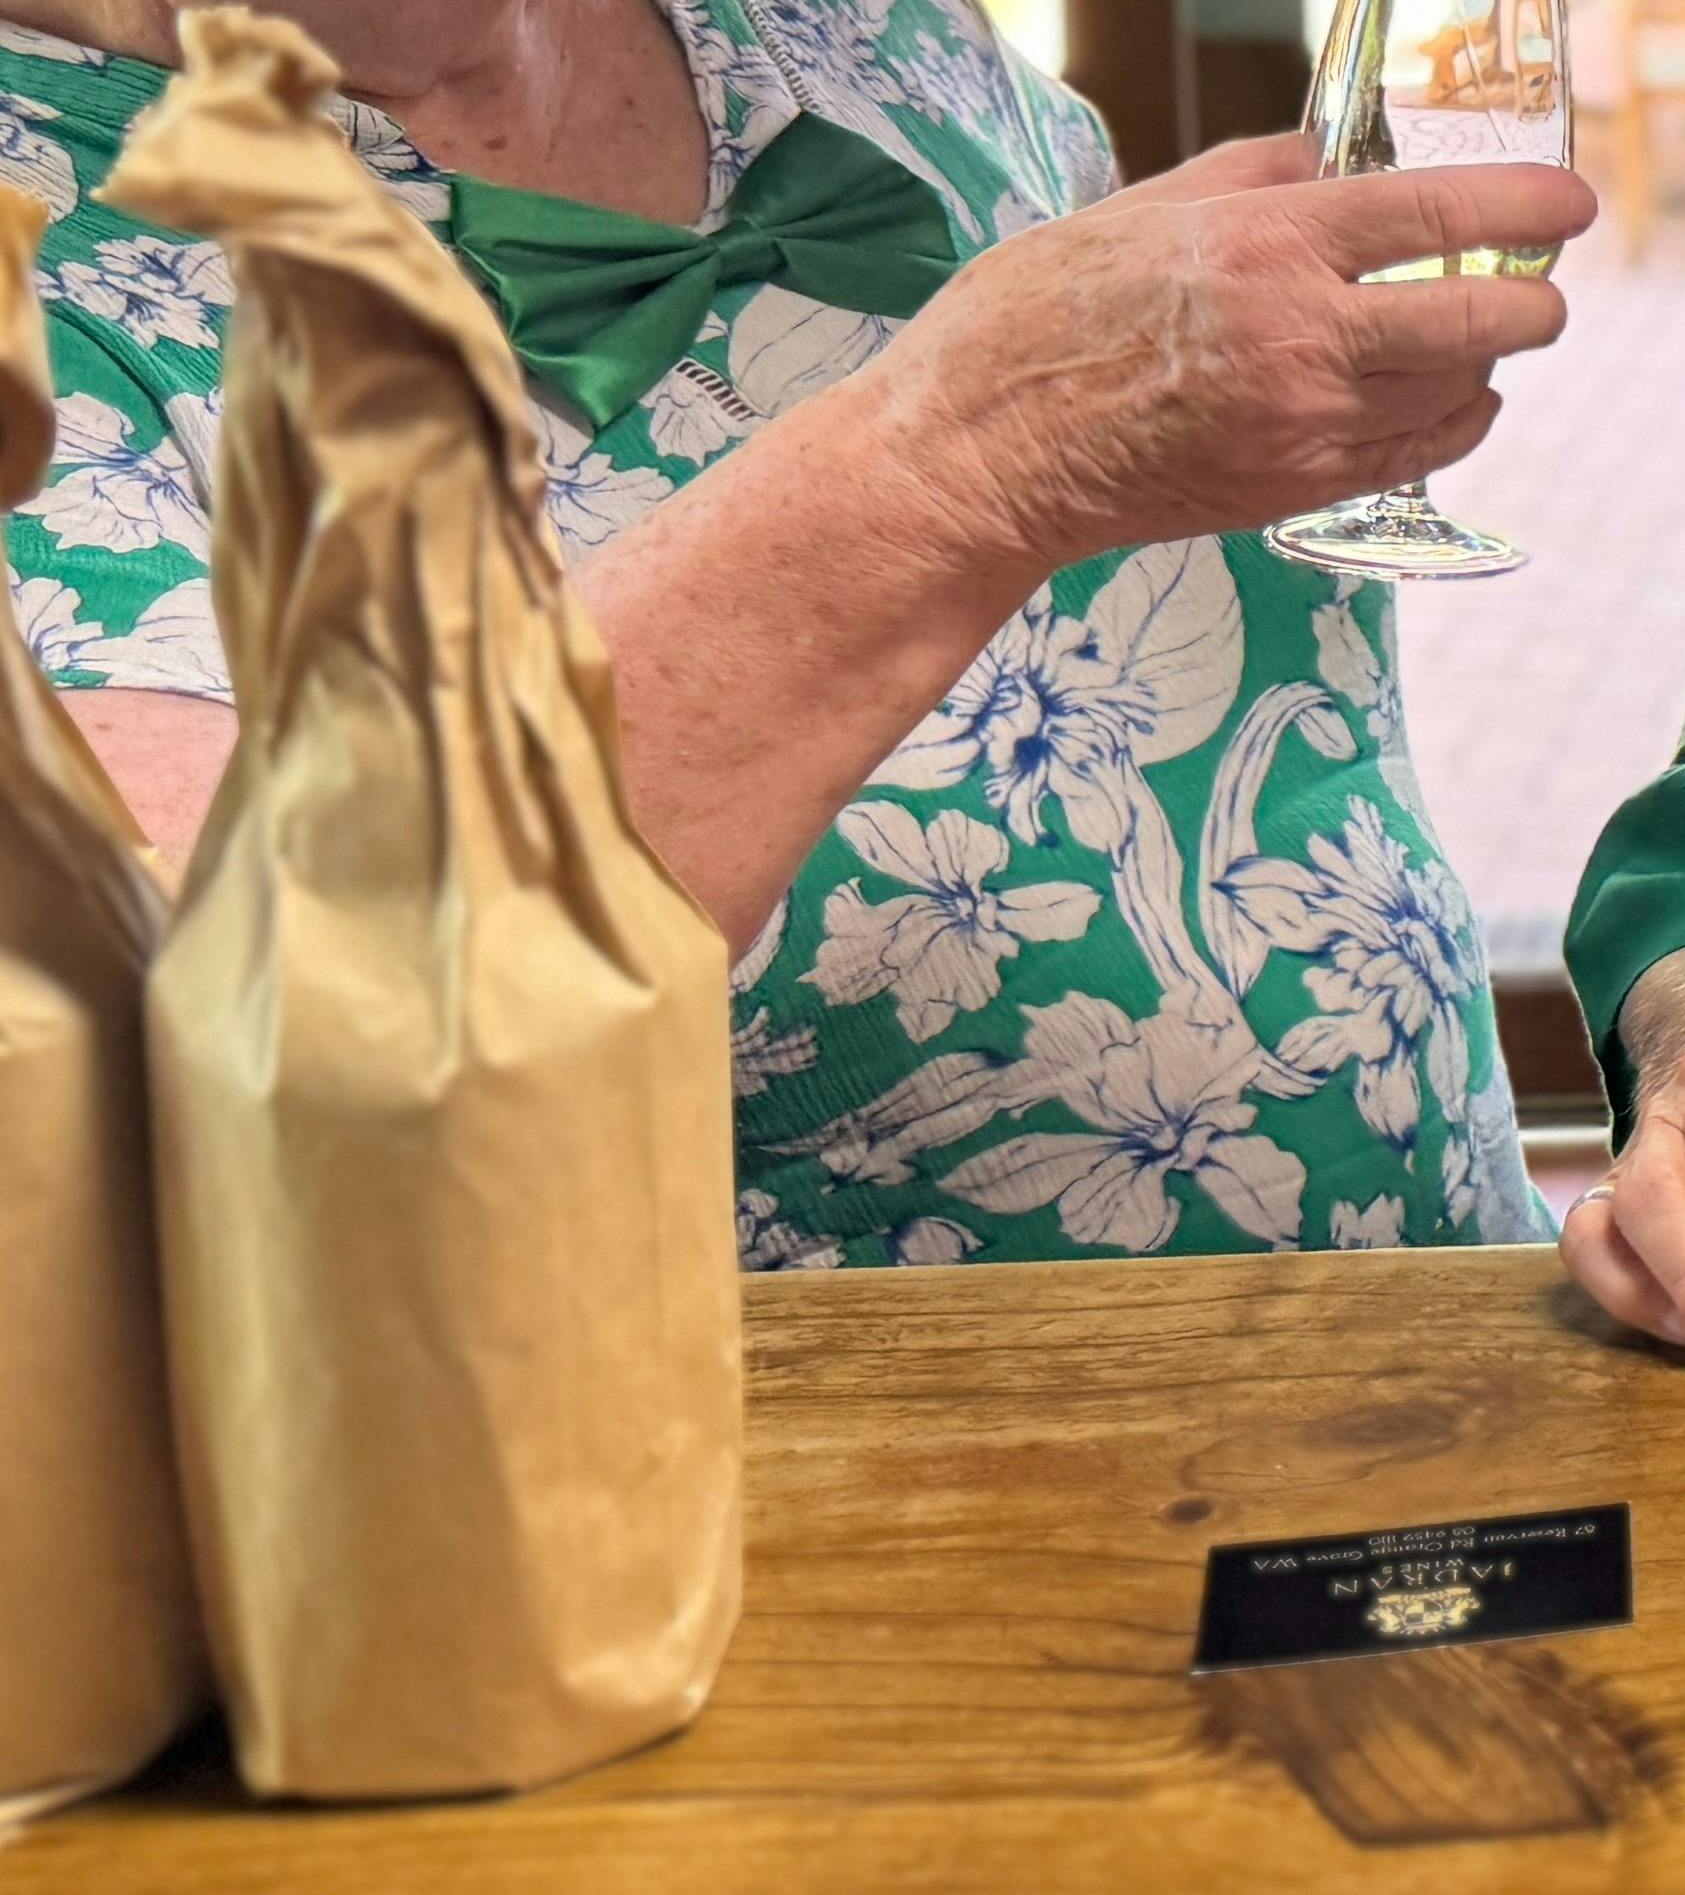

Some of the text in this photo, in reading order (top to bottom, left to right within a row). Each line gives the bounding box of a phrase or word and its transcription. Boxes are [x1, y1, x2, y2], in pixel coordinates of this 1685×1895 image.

[1448, 1537, 1475, 1550] Rd
[1252, 1557, 1297, 1571] WA
[1305, 1549, 1363, 1564] Grove
[1381, 1557, 1464, 1574] WINES
[1330, 1561, 1513, 1597] JADRAN
